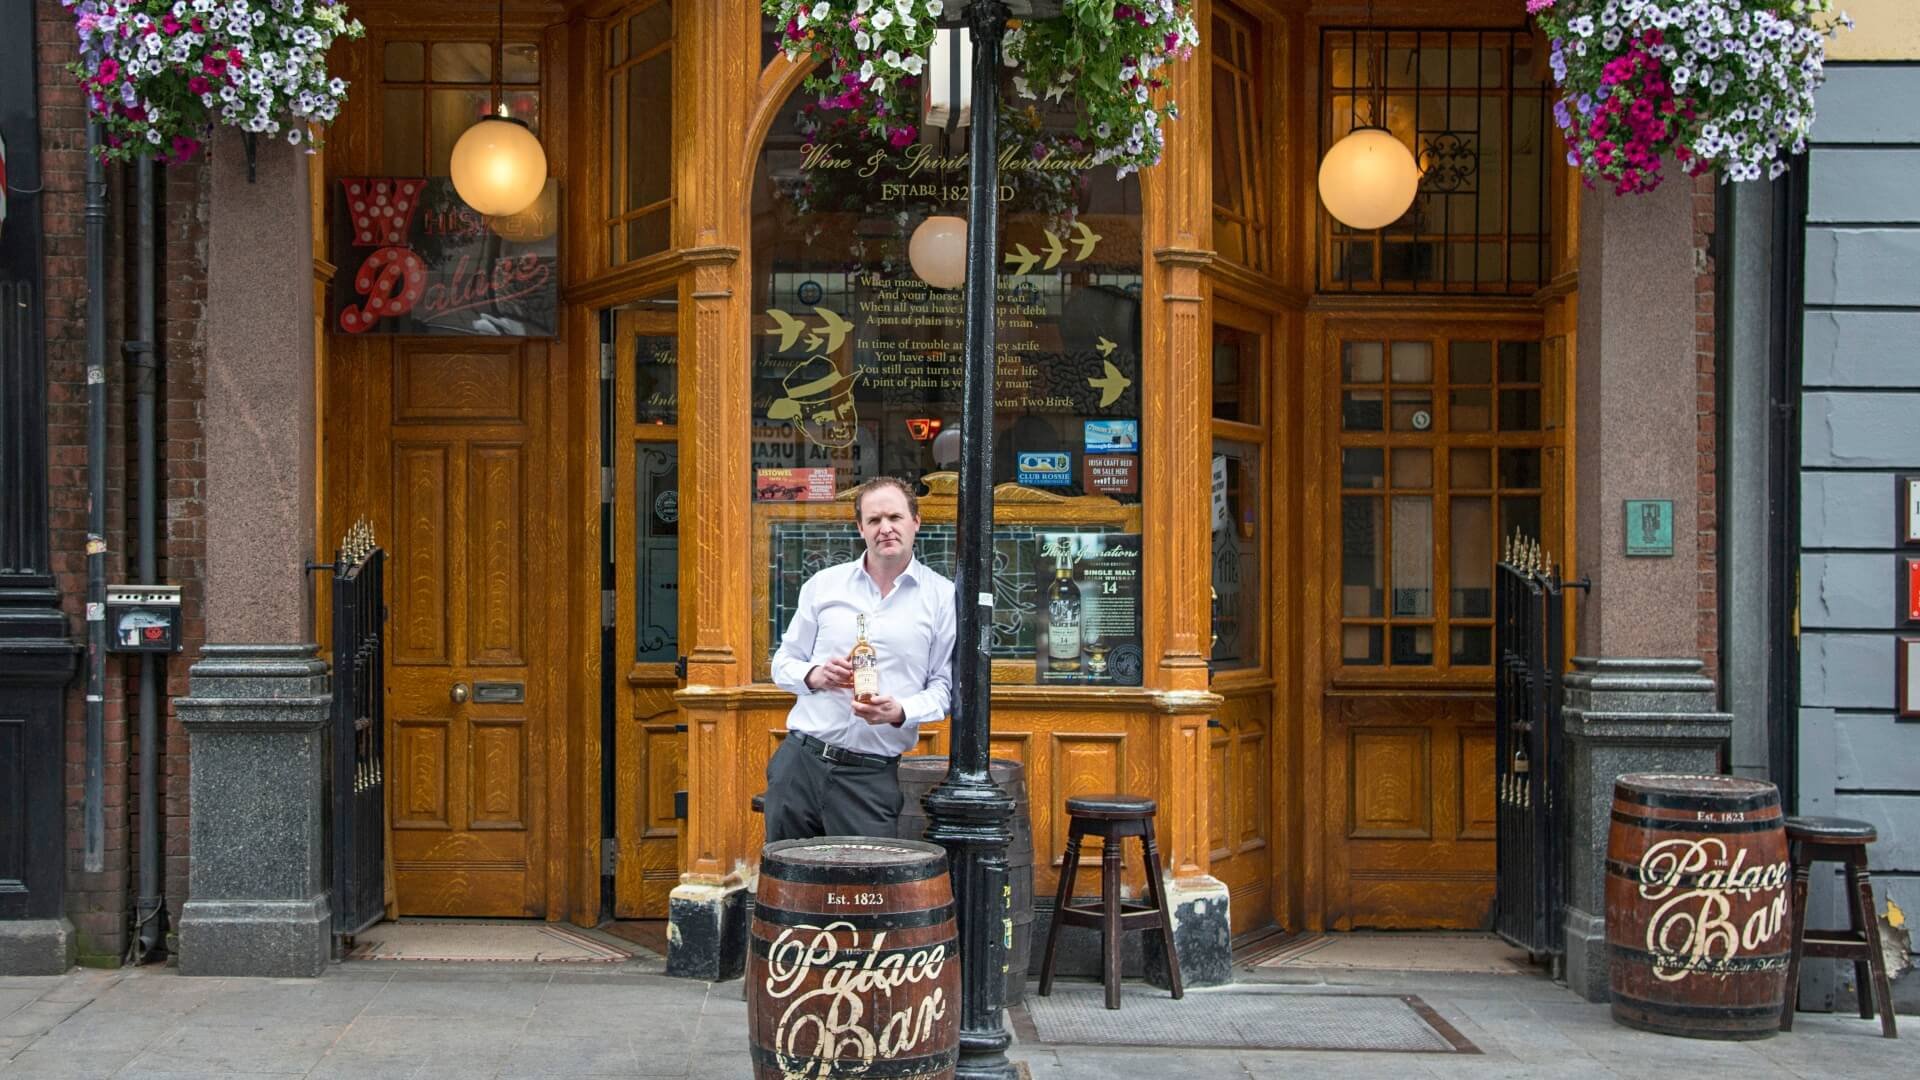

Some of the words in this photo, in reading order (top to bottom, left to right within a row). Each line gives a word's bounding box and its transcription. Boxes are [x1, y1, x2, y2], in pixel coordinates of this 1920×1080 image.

[800, 143, 851, 169] Wine
[858, 149, 887, 177] &
[896, 143, 968, 178] Spirit
[942, 186, 968, 200] 182
[861, 276, 891, 289] When
[879, 290, 899, 300] And
[902, 292, 926, 303] your
[929, 290, 958, 300] horse
[860, 302, 890, 312] When
[894, 302, 906, 312] all
[910, 304, 929, 315] you
[932, 303, 957, 313] have
[1010, 304, 1019, 315] of
[1023, 304, 1046, 316] debt
[866, 315, 874, 325] A
[877, 316, 898, 327] pint
[902, 315, 912, 325] of
[914, 315, 941, 327] plain
[945, 316, 954, 326] is
[858, 339, 869, 349] In
[872, 340, 896, 349] time
[898, 339, 909, 349] of
[912, 339, 950, 350] trouble
[1011, 341, 1040, 352] strife
[874, 352, 896, 362] You
[900, 352, 924, 362] have
[927, 352, 946, 362] still
[950, 354, 956, 362] a
[998, 353, 1021, 365] plan
[859, 364, 879, 374] You
[882, 364, 901, 374] still
[904, 366, 924, 374] can
[927, 365, 947, 374] turn
[1022, 366, 1038, 376] life
[862, 377, 870, 387] A
[873, 377, 894, 389] pint
[897, 377, 907, 387] of
[910, 377, 937, 389] plain
[941, 378, 950, 388] is
[1021, 397, 1043, 407] Two
[1046, 397, 1074, 407] Birds
[1104, 459, 1119, 467] CRAFT
[1102, 581, 1118, 594] 14
[1697, 811, 1717, 822] Est.
[1721, 812, 1745, 822] 1823
[1639, 838, 1787, 900] Palace
[827, 893, 850, 905] Est.
[854, 893, 884, 905] 1823
[1646, 889, 1788, 982] Bar
[766, 921, 946, 998] Palace
[775, 988, 946, 1080] Bar
